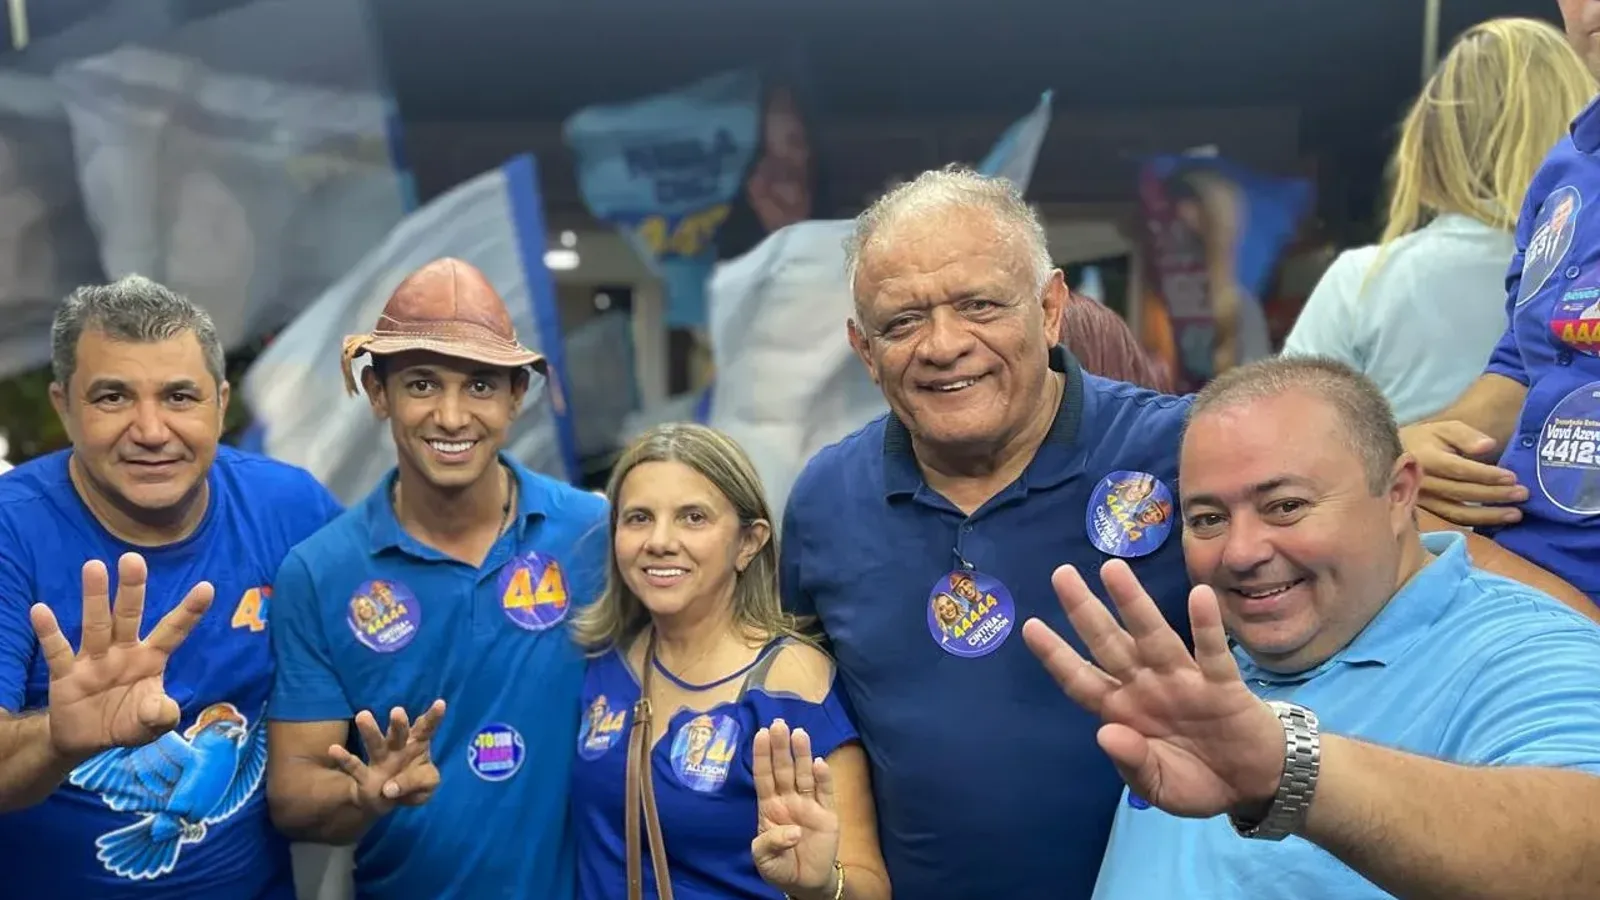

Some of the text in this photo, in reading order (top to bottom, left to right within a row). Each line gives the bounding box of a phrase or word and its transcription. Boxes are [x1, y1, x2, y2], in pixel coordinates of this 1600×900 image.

[503, 561, 566, 614] 44
[954, 593, 998, 639] 44444
[968, 615, 999, 646] CINTHIA
[980, 617, 1009, 645] ALLYSON
[685, 763, 727, 776] ALLYSON
